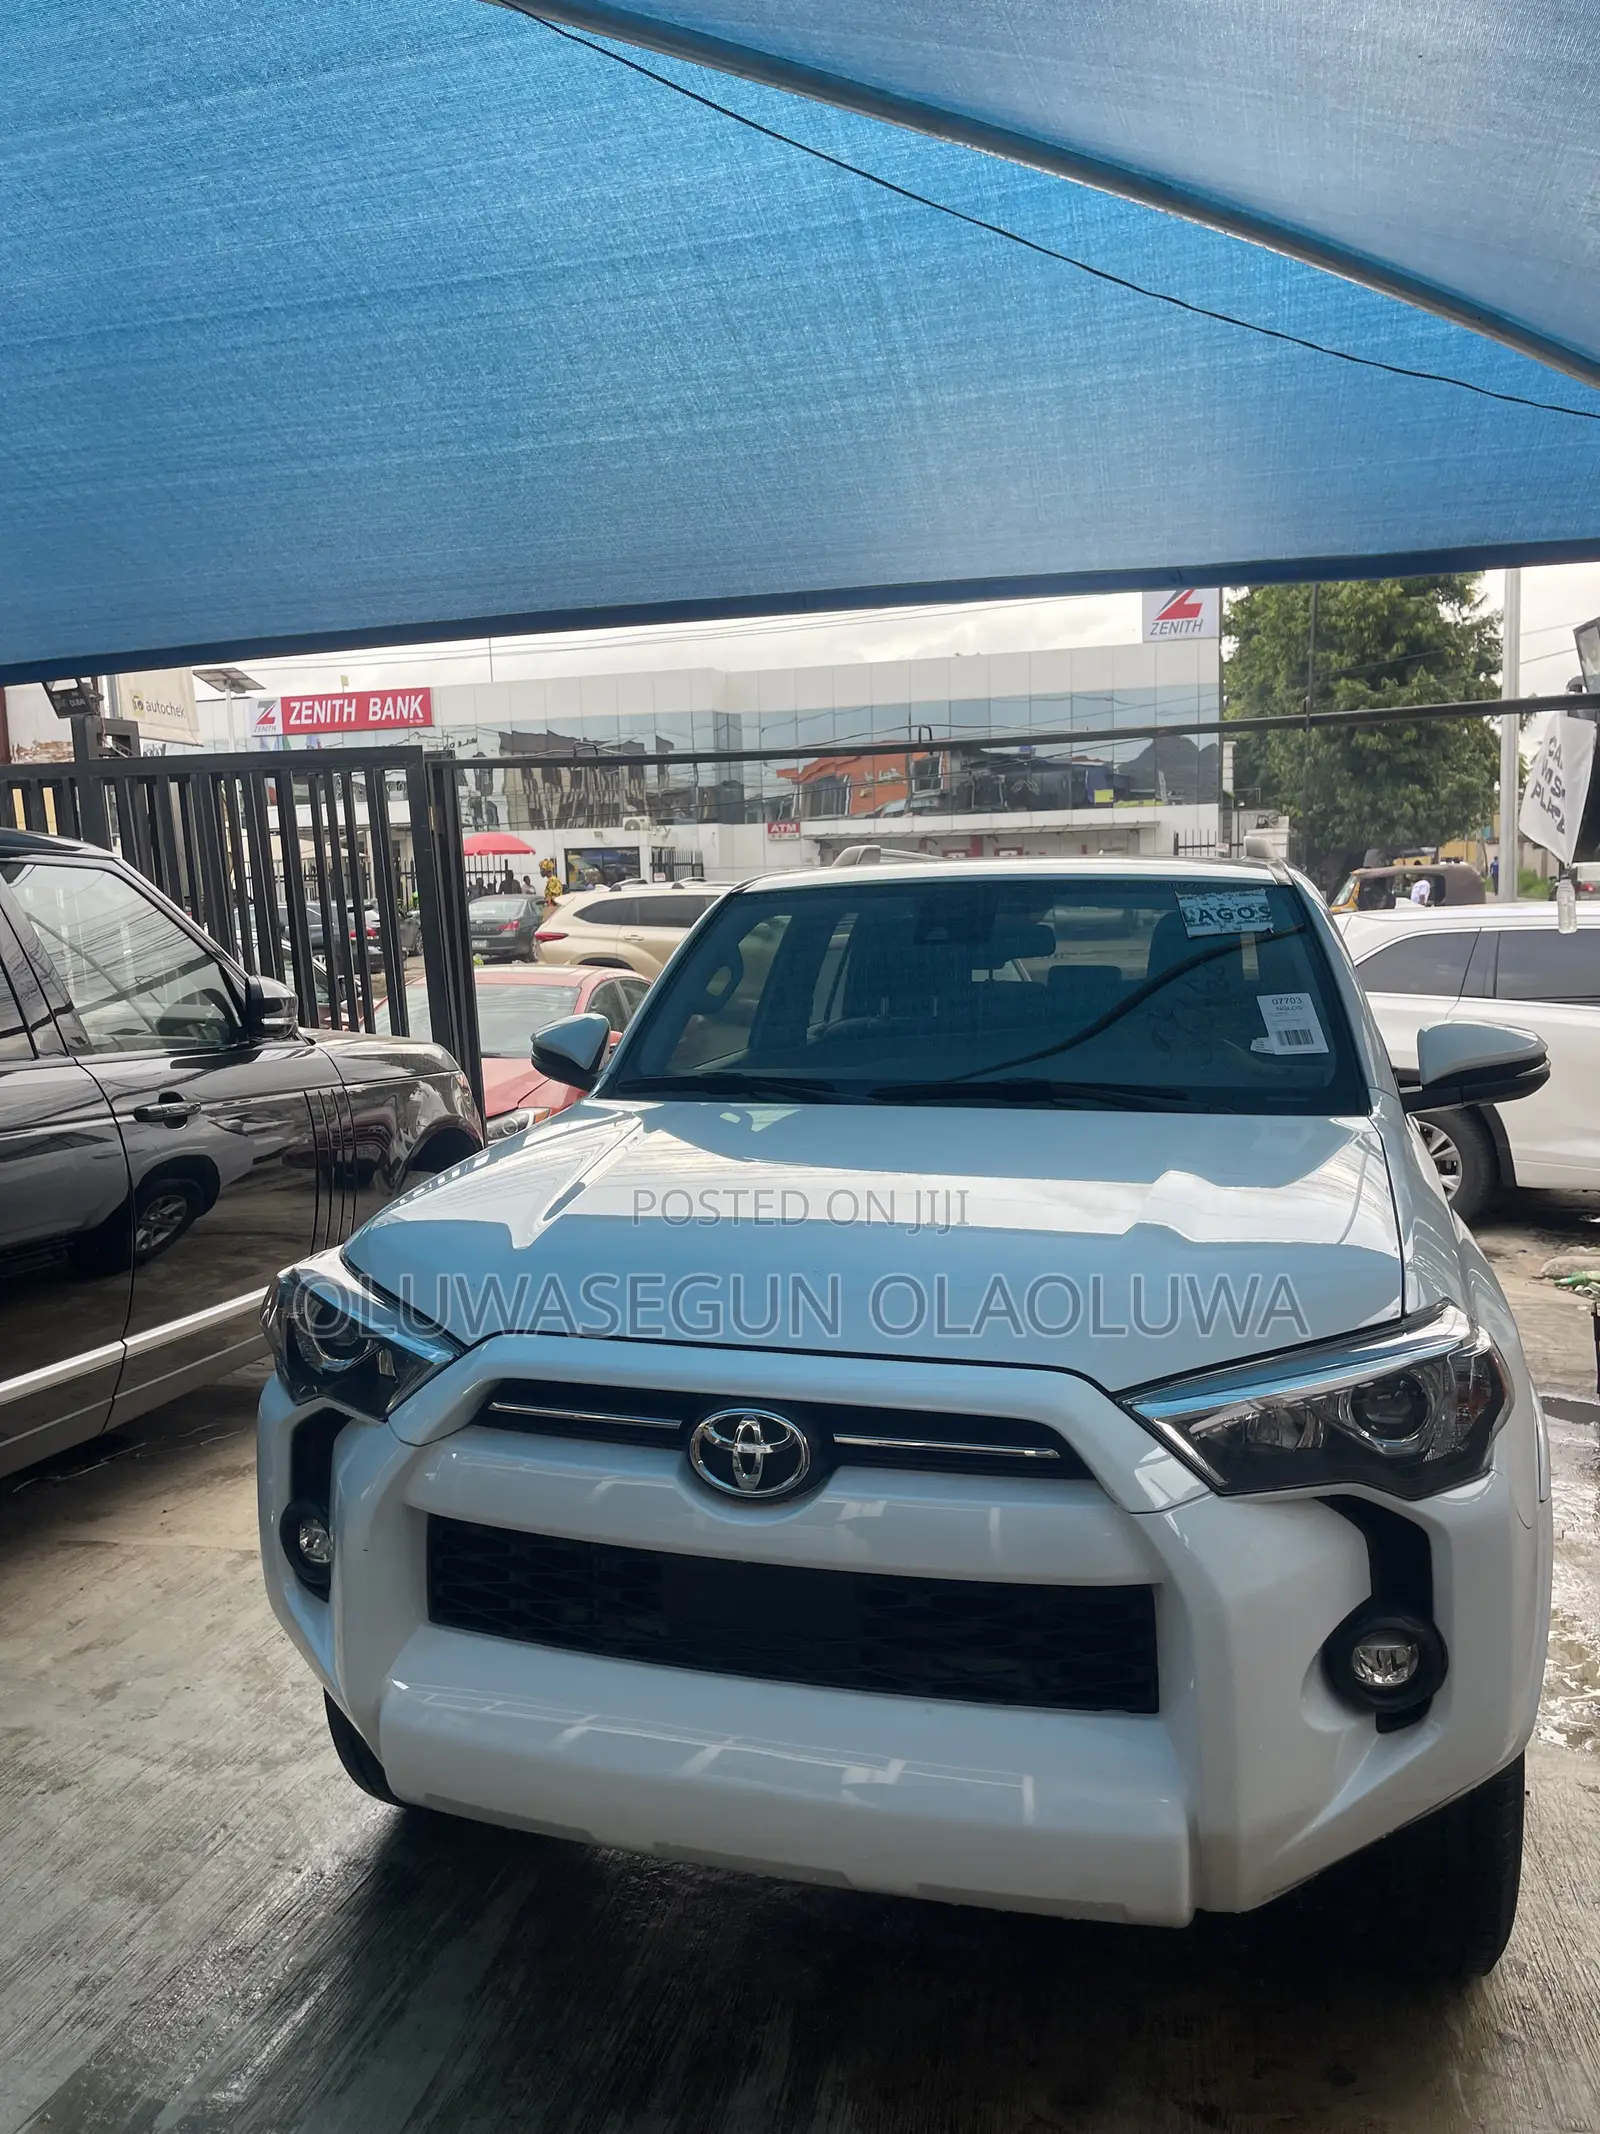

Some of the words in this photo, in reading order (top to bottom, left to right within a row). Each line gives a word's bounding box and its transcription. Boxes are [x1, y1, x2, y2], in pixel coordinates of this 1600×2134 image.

[1149, 618, 1204, 636] ZENITH
[289, 698, 357, 726] ZENITH
[368, 694, 424, 722] BANK
[253, 725, 277, 733] ZENITH
[770, 823, 797, 833] ATM
[1271, 996, 1303, 1006] 07703
